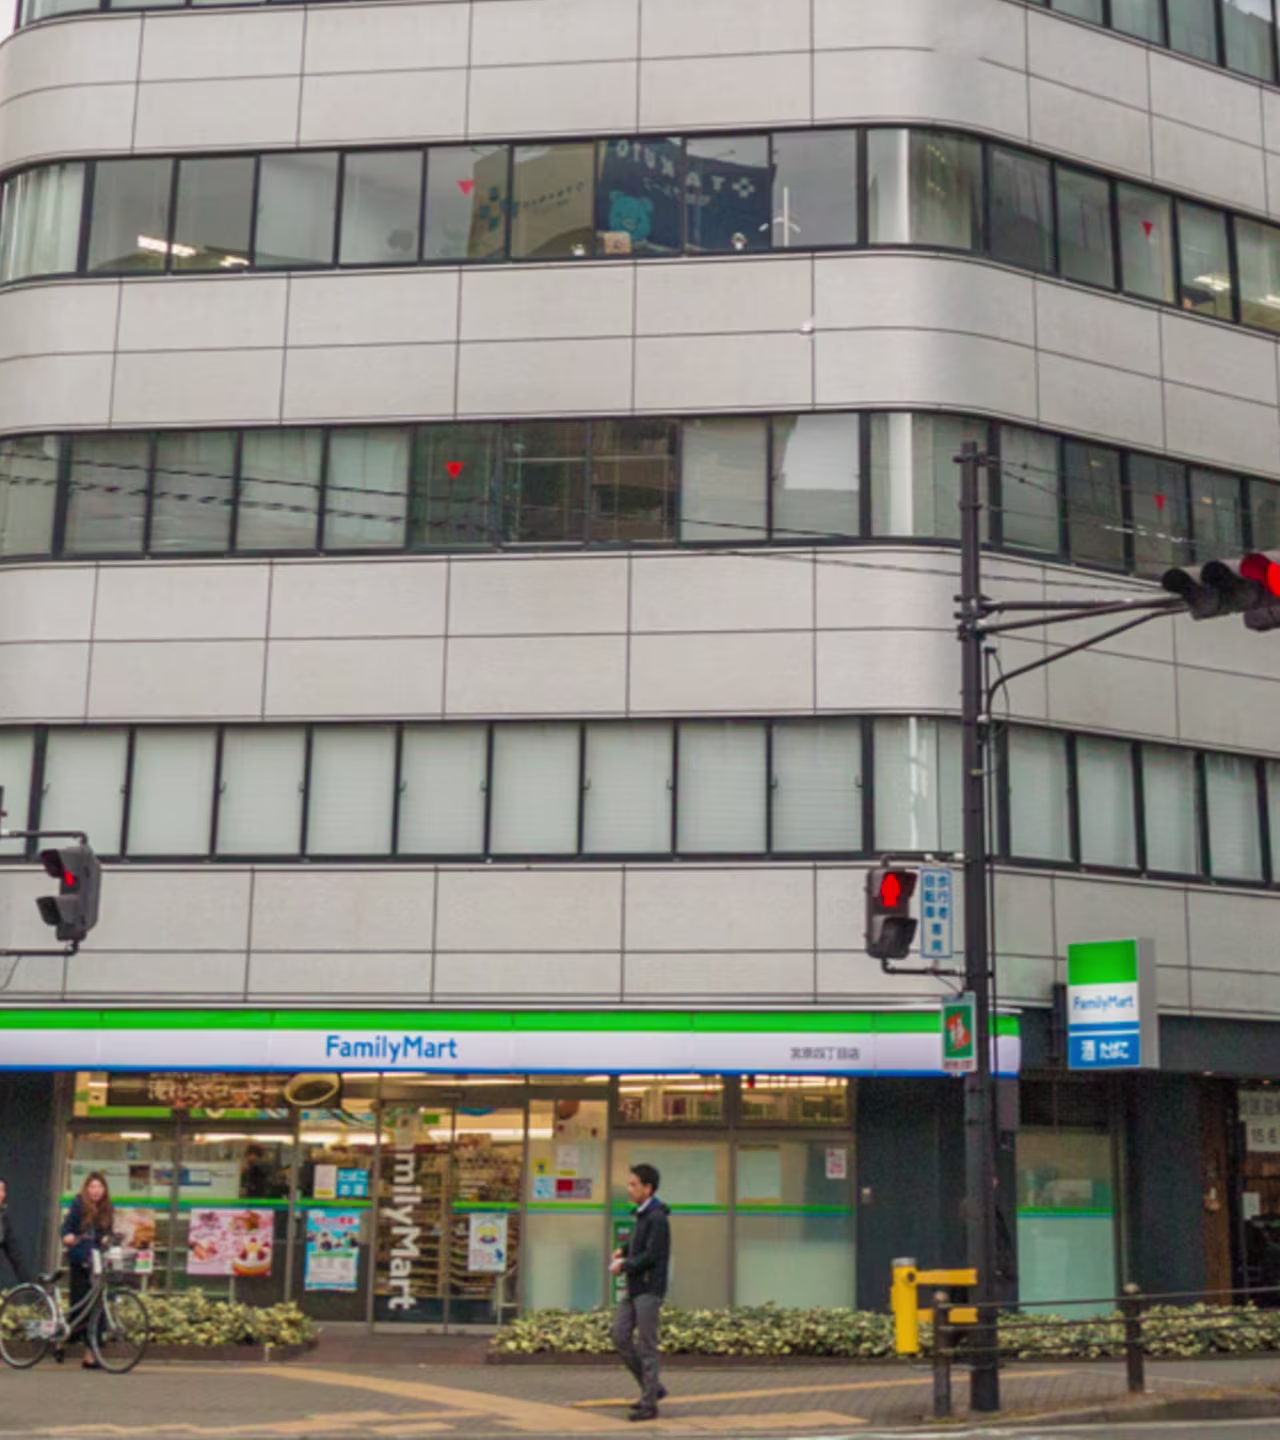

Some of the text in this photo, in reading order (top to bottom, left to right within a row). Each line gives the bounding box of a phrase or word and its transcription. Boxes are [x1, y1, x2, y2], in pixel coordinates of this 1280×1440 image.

[1072, 994, 1135, 1013] FamilyMart
[325, 1034, 458, 1064] FamilyMart
[1099, 1041, 1130, 1060] たばこ
[377, 1114, 423, 1311] milyMart
